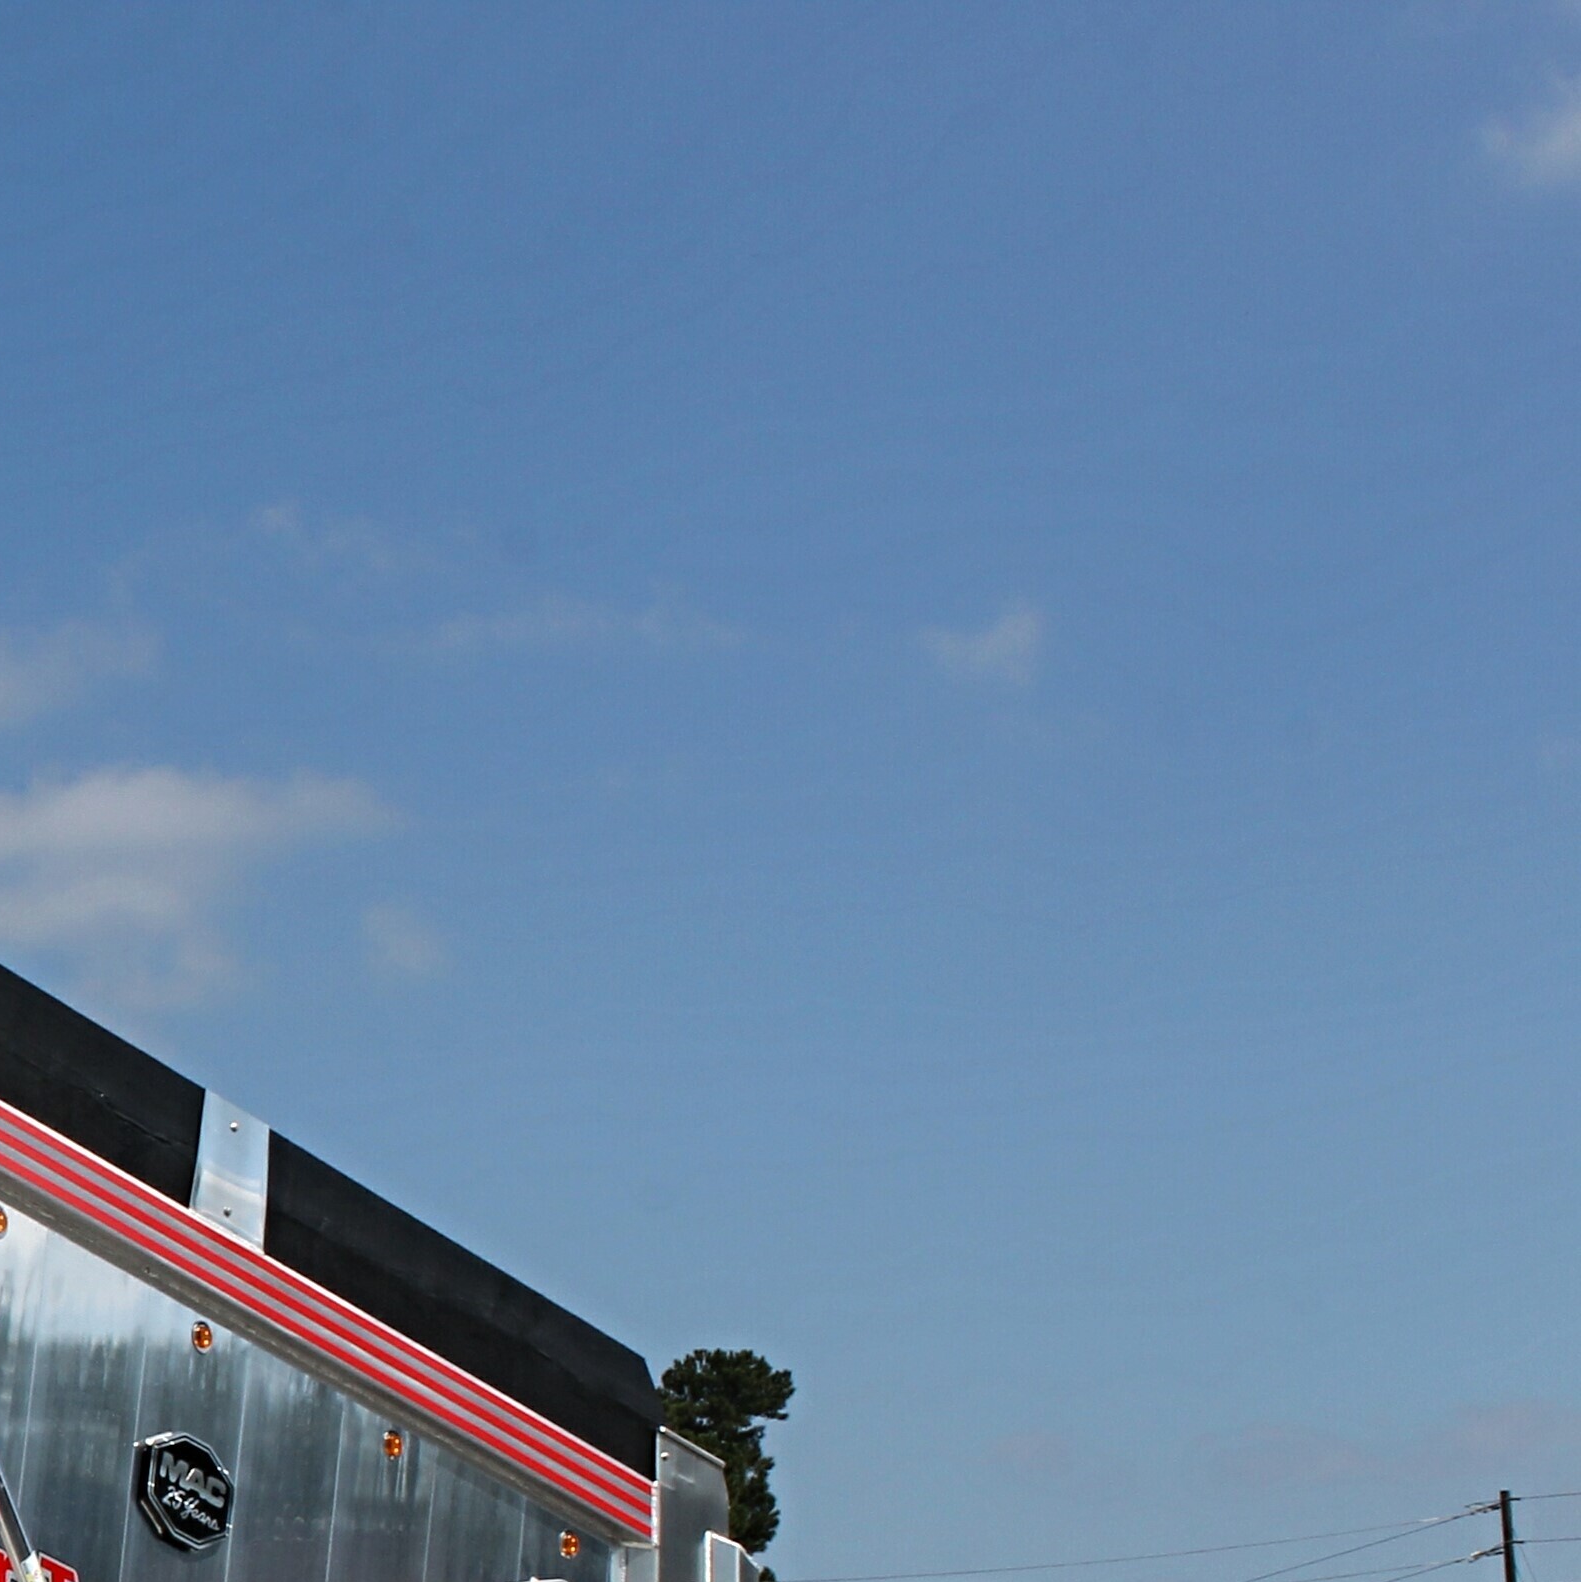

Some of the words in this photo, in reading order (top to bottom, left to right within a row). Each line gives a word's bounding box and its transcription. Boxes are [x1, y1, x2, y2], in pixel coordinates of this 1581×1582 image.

[160, 1451, 227, 1508] MAC
[163, 1485, 186, 1510] 25
[181, 1497, 220, 1531] Years
